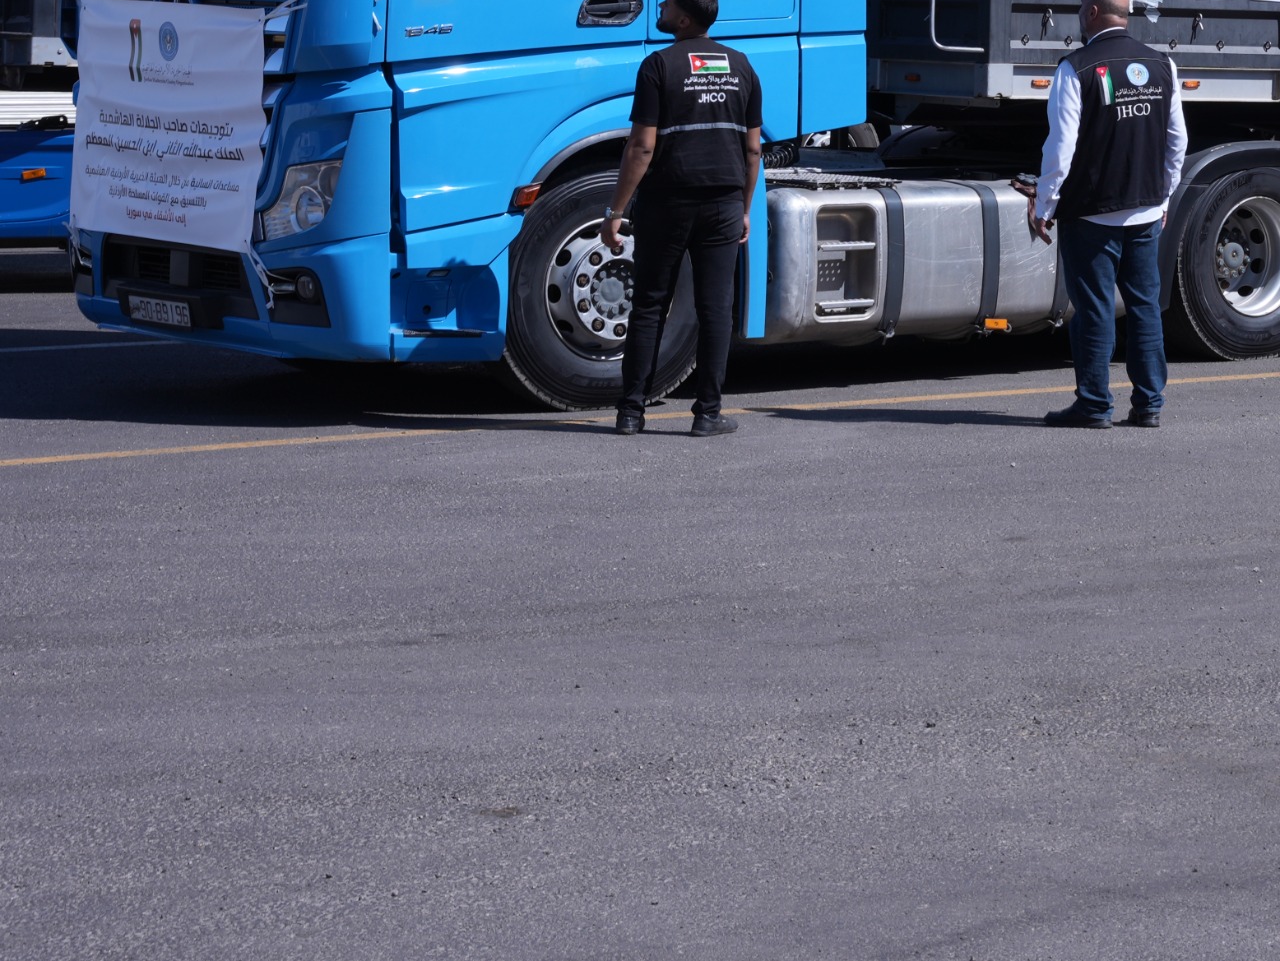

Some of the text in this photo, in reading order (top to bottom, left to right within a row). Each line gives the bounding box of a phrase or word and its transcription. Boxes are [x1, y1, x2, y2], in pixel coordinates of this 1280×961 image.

[698, 92, 726, 103] JHCO
[1116, 103, 1151, 121] JHCO
[99, 109, 234, 140] بتوجيهات صاحب الجلالة الهاشمية
[86, 131, 114, 150] المعظم
[156, 140, 182, 161] الثاني
[182, 139, 213, 162] عبدالله
[214, 145, 244, 161] الملك
